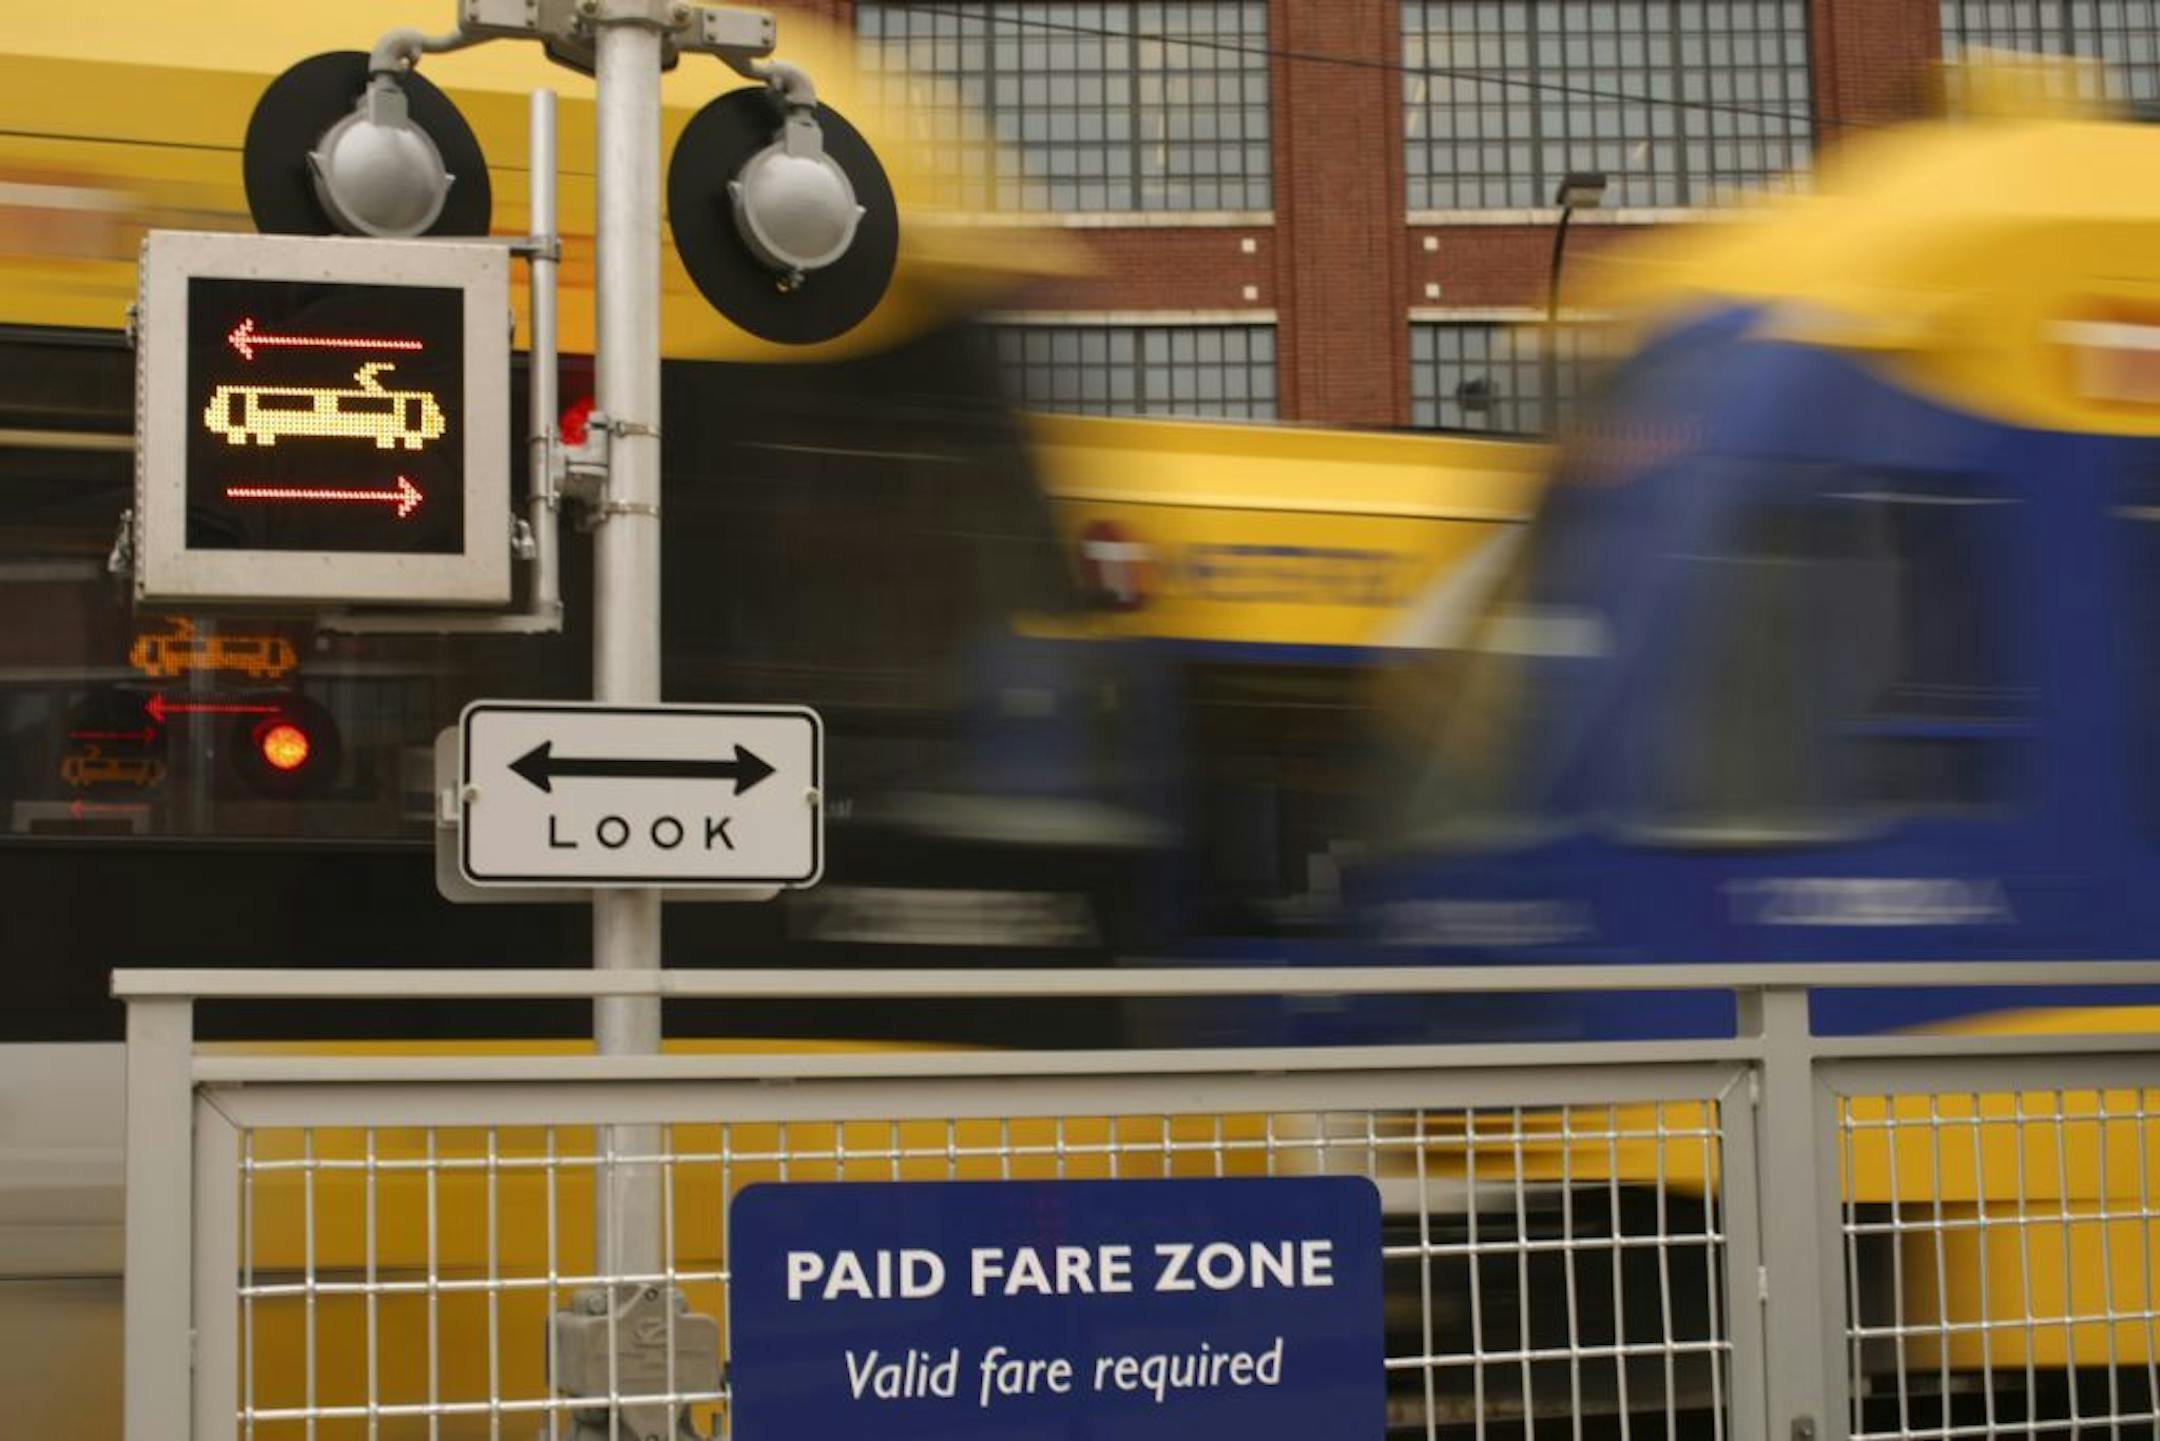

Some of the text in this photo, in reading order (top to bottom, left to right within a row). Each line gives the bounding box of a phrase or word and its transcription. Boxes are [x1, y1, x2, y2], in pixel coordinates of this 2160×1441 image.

[548, 814, 735, 851] LOOK
[787, 1240, 1334, 1301] PAID FARE ZONE
[845, 1336, 1284, 1407] Valid fare required
